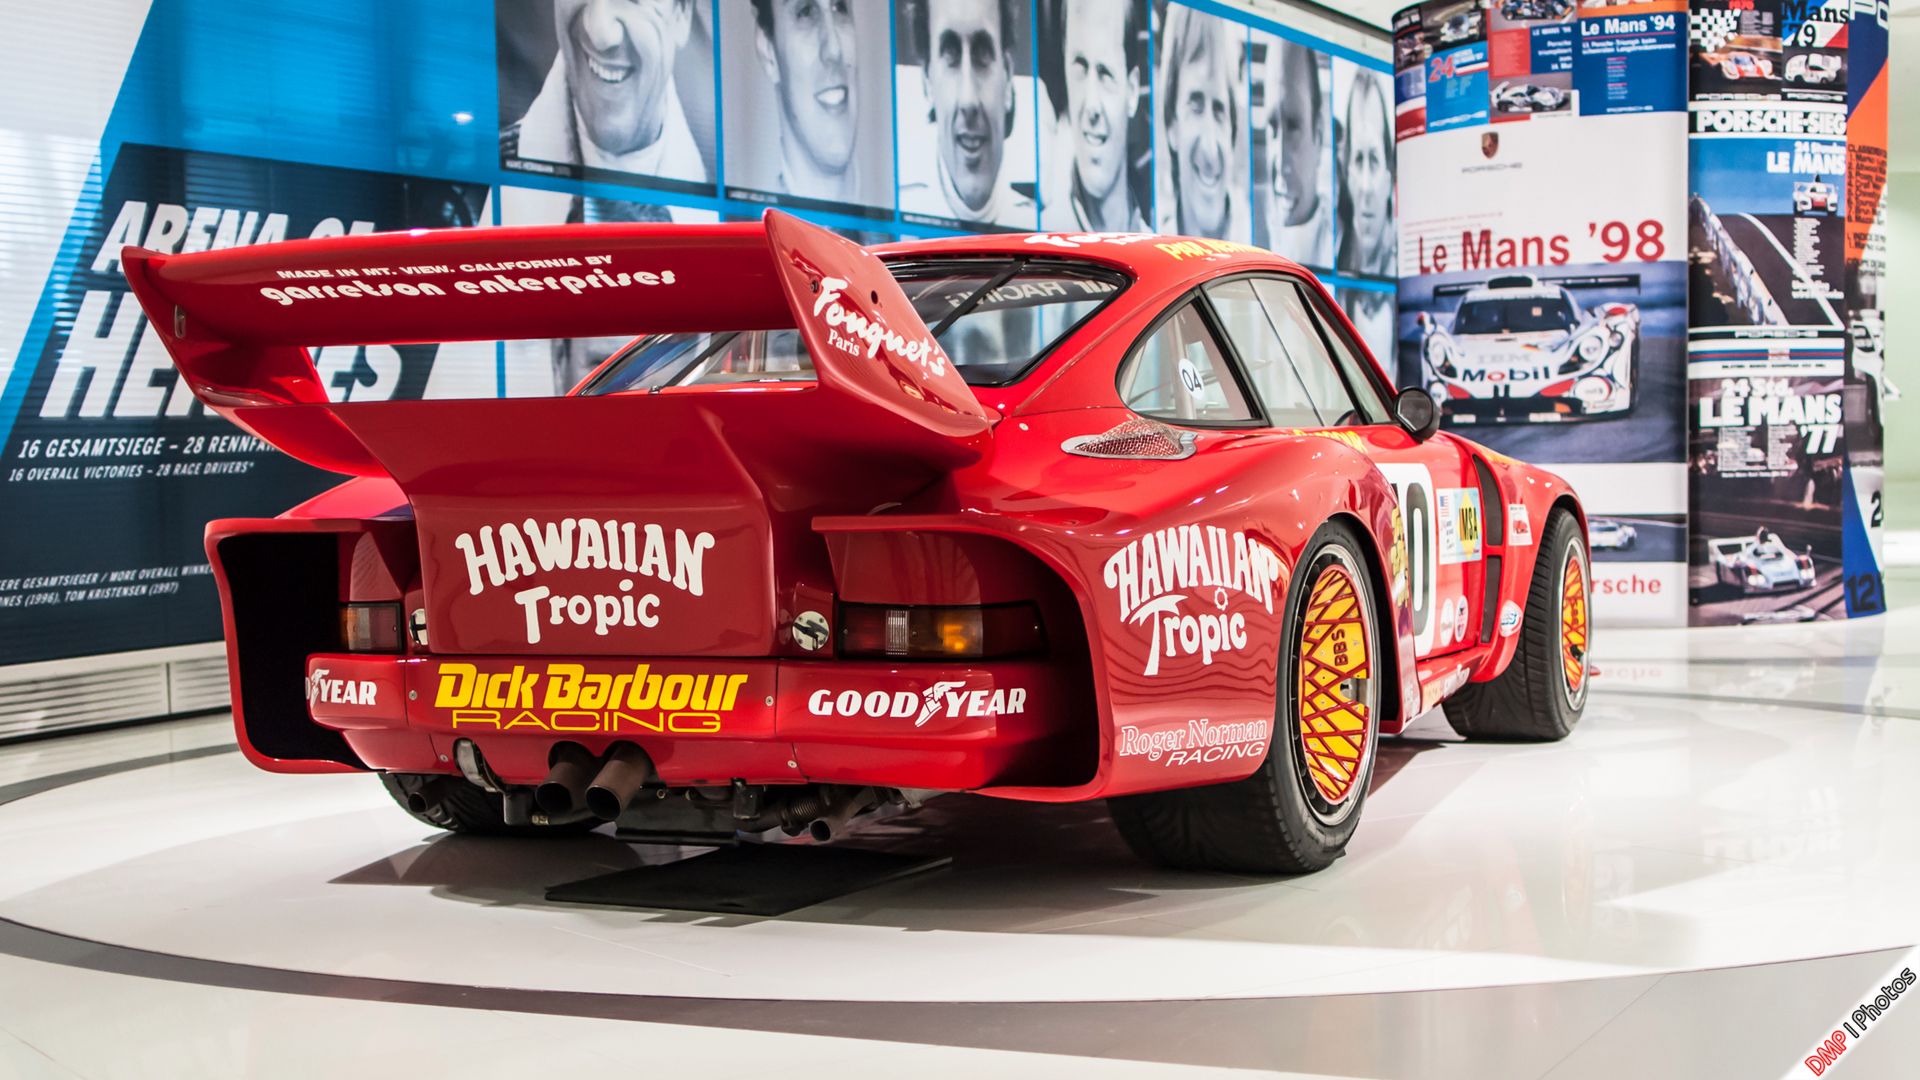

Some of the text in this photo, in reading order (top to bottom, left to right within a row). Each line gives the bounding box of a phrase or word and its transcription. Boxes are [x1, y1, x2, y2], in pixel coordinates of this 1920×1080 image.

[1581, 20, 1599, 36] Le
[1604, 18, 1648, 35] Mans
[1697, 110, 1846, 135] PORSCHE-SIEG
[1767, 151, 1846, 175] LE MANS
[1418, 235, 1448, 275] Le
[1462, 229, 1570, 271] Mans
[276, 270, 335, 279] MADE
[336, 268, 360, 278] IN
[361, 267, 397, 276] MT.
[459, 257, 582, 273] CALIFORNIA
[584, 254, 613, 265] BY
[260, 268, 677, 306] garretson enterprises
[827, 329, 860, 357] Paris
[1462, 365, 1550, 382] Mobil
[1700, 394, 1842, 428] LE MANS
[18, 440, 41, 458] 16
[45, 437, 165, 458] GESAMTSIEGE
[183, 436, 202, 454] 28
[9, 469, 24, 482] 16
[26, 467, 81, 481] OVERALL
[83, 465, 143, 479] VICTORIES
[156, 464, 171, 476] 28
[173, 463, 202, 475] RACE
[455, 518, 715, 596] HAWAIIAN
[22, 572, 99, 589] GESAMTSIEGER
[109, 569, 136, 582] MORE
[138, 566, 178, 580] OVERALL
[1103, 524, 1279, 622] HAWAIIAN
[64, 588, 85, 602] TOM
[87, 585, 147, 600] KRISTENSEN
[514, 578, 661, 644] Tropic
[1128, 594, 1247, 676] Tropic
[1331, 628, 1348, 667] BBS
[434, 663, 749, 711] Dick Barbour
[452, 709, 722, 733] RACING
[1119, 718, 1267, 762] Roger Norman
[1165, 740, 1265, 767] RACING
